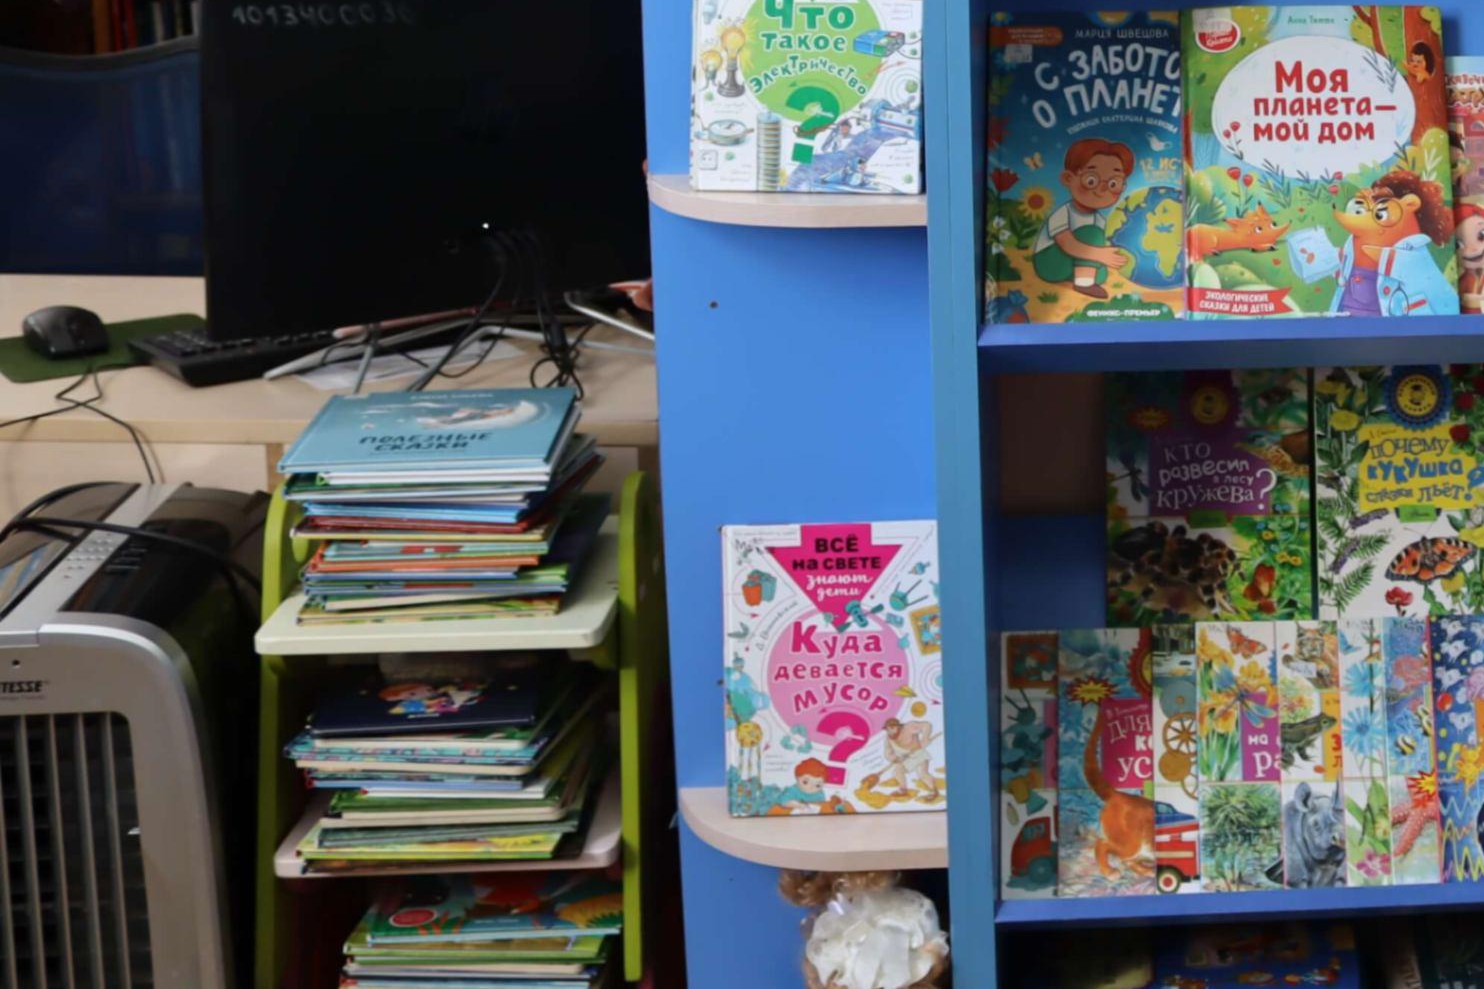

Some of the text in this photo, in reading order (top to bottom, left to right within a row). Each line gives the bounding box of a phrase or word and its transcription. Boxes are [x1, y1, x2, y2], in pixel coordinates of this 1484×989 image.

[761, 33, 846, 51] такое
[1034, 62, 1060, 91] С
[1275, 61, 1349, 93] Моя
[1032, 99, 1058, 129] О
[1254, 119, 1375, 144] мой дом
[1231, 302, 1249, 313] ДЛЯ
[1250, 302, 1275, 313] ДЕТЕЙ
[815, 534, 858, 553] ВСЁ
[823, 556, 881, 570] СВЕТЕ
[806, 573, 873, 590] знают
[817, 586, 862, 602] дети
[791, 621, 882, 658] Куда
[774, 662, 902, 681] девается
